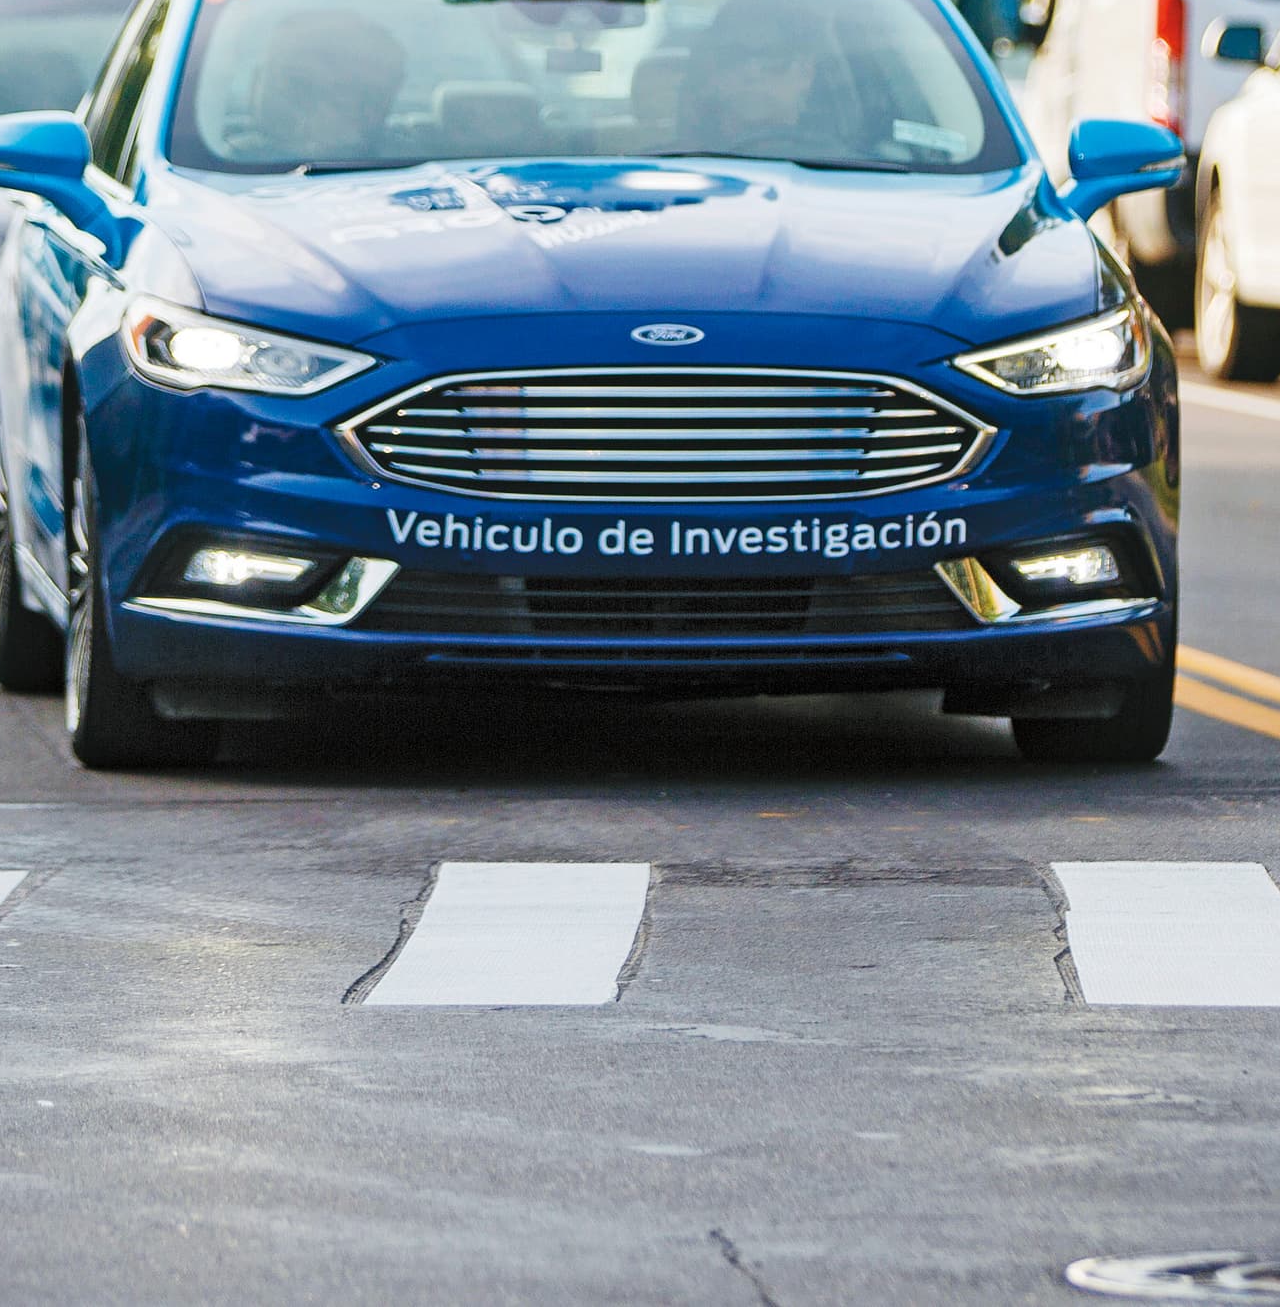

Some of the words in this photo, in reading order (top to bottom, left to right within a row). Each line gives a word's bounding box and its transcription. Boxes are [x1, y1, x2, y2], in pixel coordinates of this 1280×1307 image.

[386, 507, 584, 554] Vehiculo
[598, 519, 655, 555] de
[671, 511, 968, 558] Investigación
